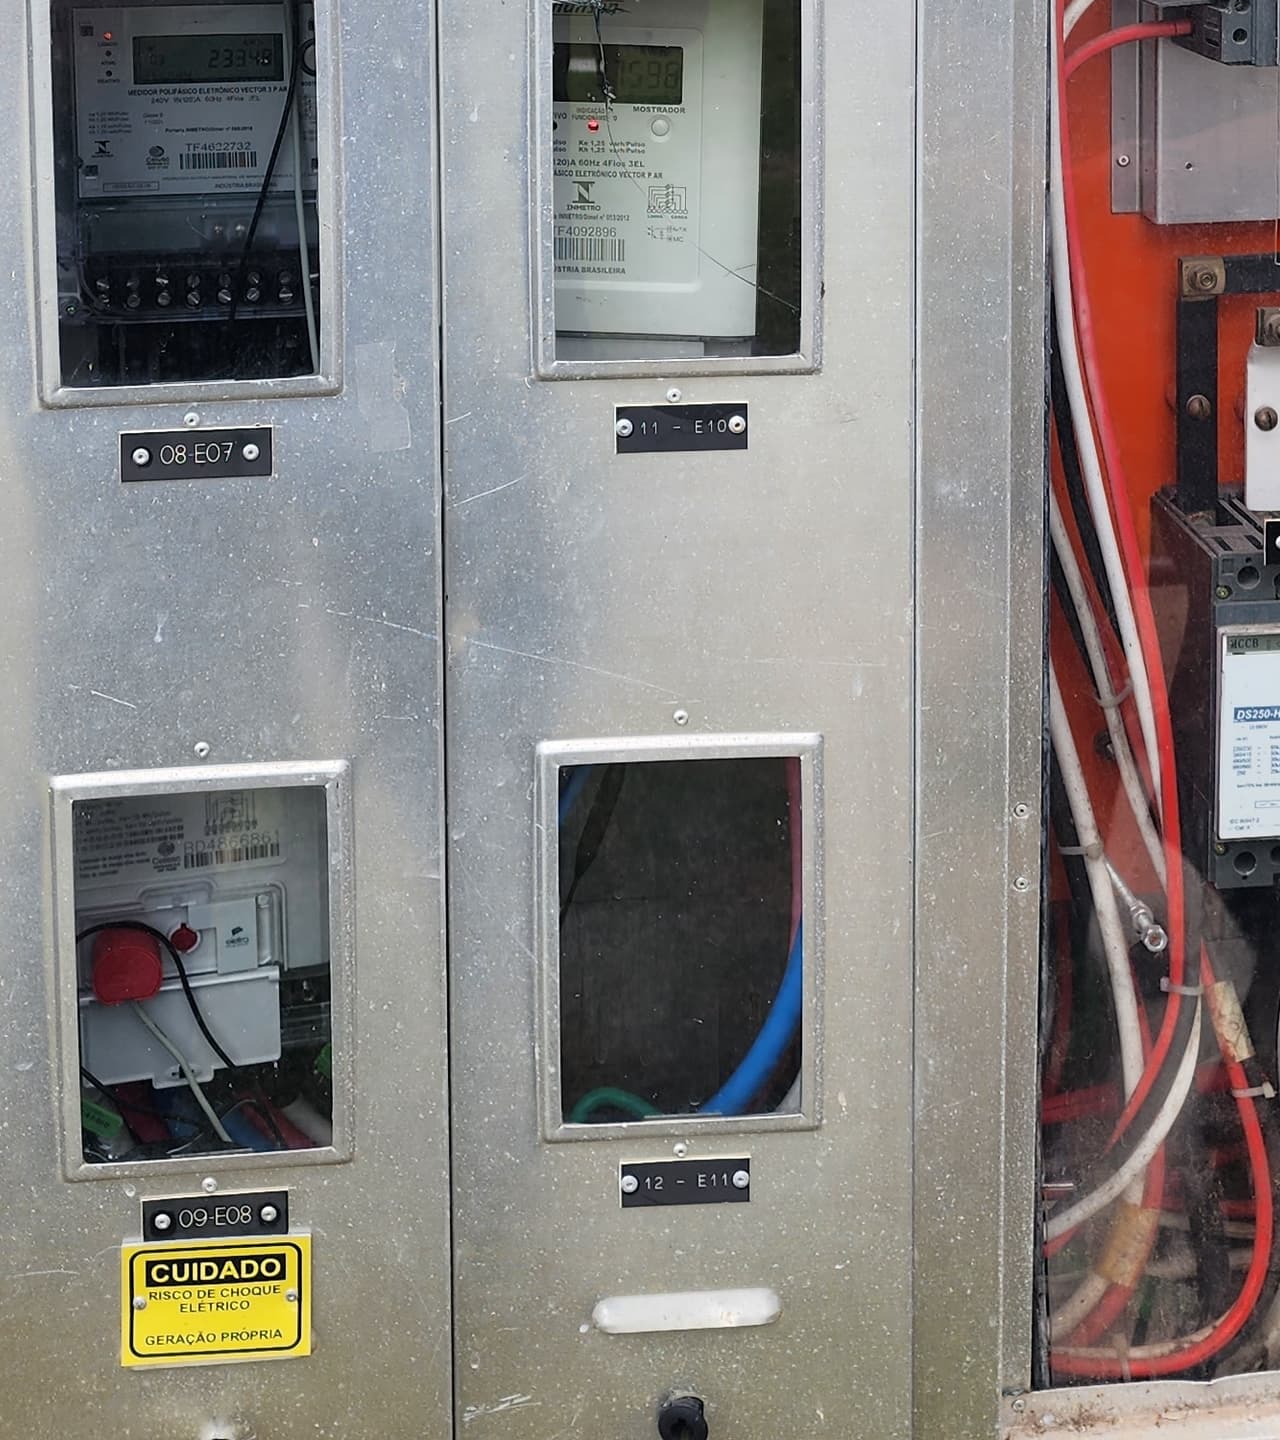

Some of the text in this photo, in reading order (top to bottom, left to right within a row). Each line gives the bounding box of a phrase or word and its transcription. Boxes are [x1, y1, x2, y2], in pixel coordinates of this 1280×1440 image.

[633, 106, 686, 114] MOSTRADOR
[640, 422, 659, 436] 11
[695, 418, 728, 434] E10
[159, 442, 234, 465] 08-E07
[644, 1177, 664, 1191] 12
[697, 1173, 729, 1189] E11
[179, 1205, 252, 1228] 09-E08
[151, 1258, 282, 1283] CUIDADO
[148, 1284, 281, 1302] RISCO DE CHOQUE
[179, 1296, 251, 1313] ELÉTRICO
[145, 1326, 283, 1347] GERAÇÃO PRÓPRIA
